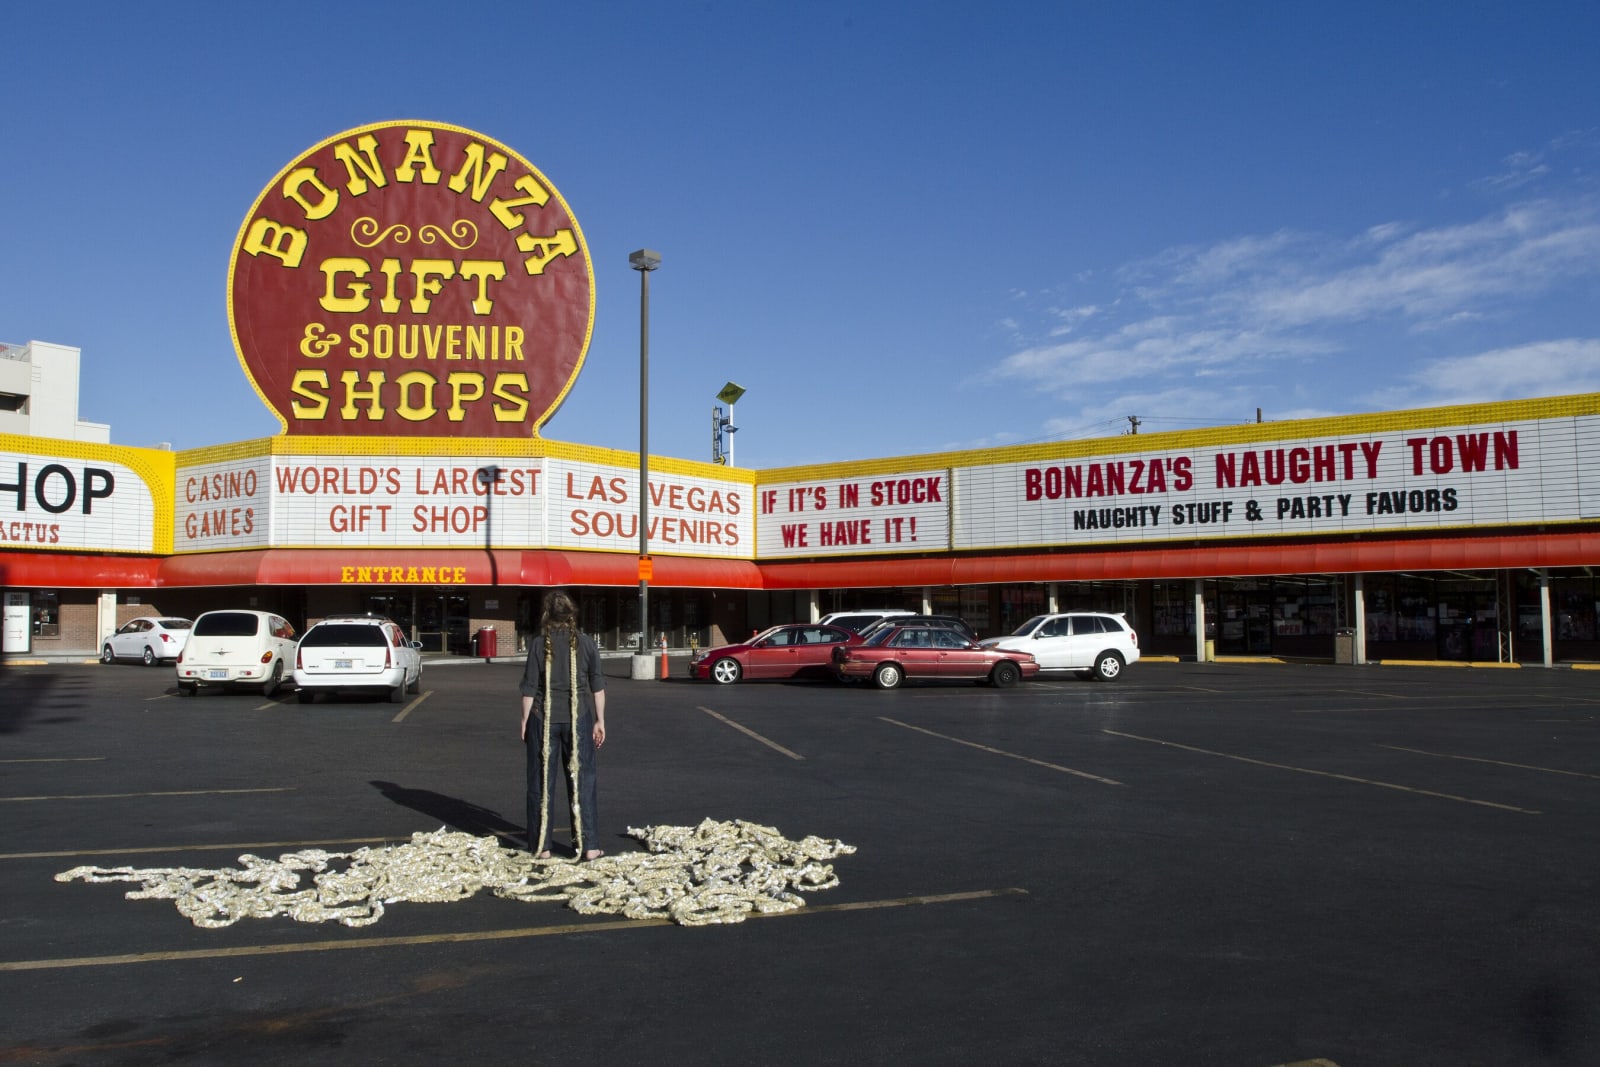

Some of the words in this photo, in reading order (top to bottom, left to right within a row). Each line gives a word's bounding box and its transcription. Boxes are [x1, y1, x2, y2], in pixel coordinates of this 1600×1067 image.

[243, 128, 579, 276] BONANZA
[318, 257, 506, 315] GIFT
[300, 322, 341, 358] &
[349, 324, 525, 361] SOUVENIR
[290, 369, 530, 422] SHOPS
[276, 466, 402, 495] WORLD'S
[416, 467, 541, 496] LARGEST
[1026, 456, 1193, 501] BONANZA'S
[1216, 440, 1382, 488] NAUGHTY
[1407, 430, 1519, 475] TOWN
[186, 469, 257, 503] CASINO
[566, 472, 628, 504] LAS
[648, 481, 741, 516] VEGAS
[761, 489, 777, 514] IF
[789, 486, 827, 513] IT'S
[839, 483, 859, 509] IN
[871, 477, 942, 507] STOCK
[185, 506, 254, 539] GAMES
[329, 505, 391, 533] GIFT
[412, 505, 488, 534] SHOP
[1073, 505, 1162, 531] NAUGHTY
[1172, 500, 1233, 525] STUFF
[1245, 499, 1263, 522] &
[1276, 494, 1352, 520] PARTY
[1365, 487, 1458, 516] FAVORS
[781, 523, 809, 549] WE
[819, 519, 872, 546] HAVE
[340, 566, 467, 584] ENTRANCE
[1279, 624, 1301, 634] OPEN
